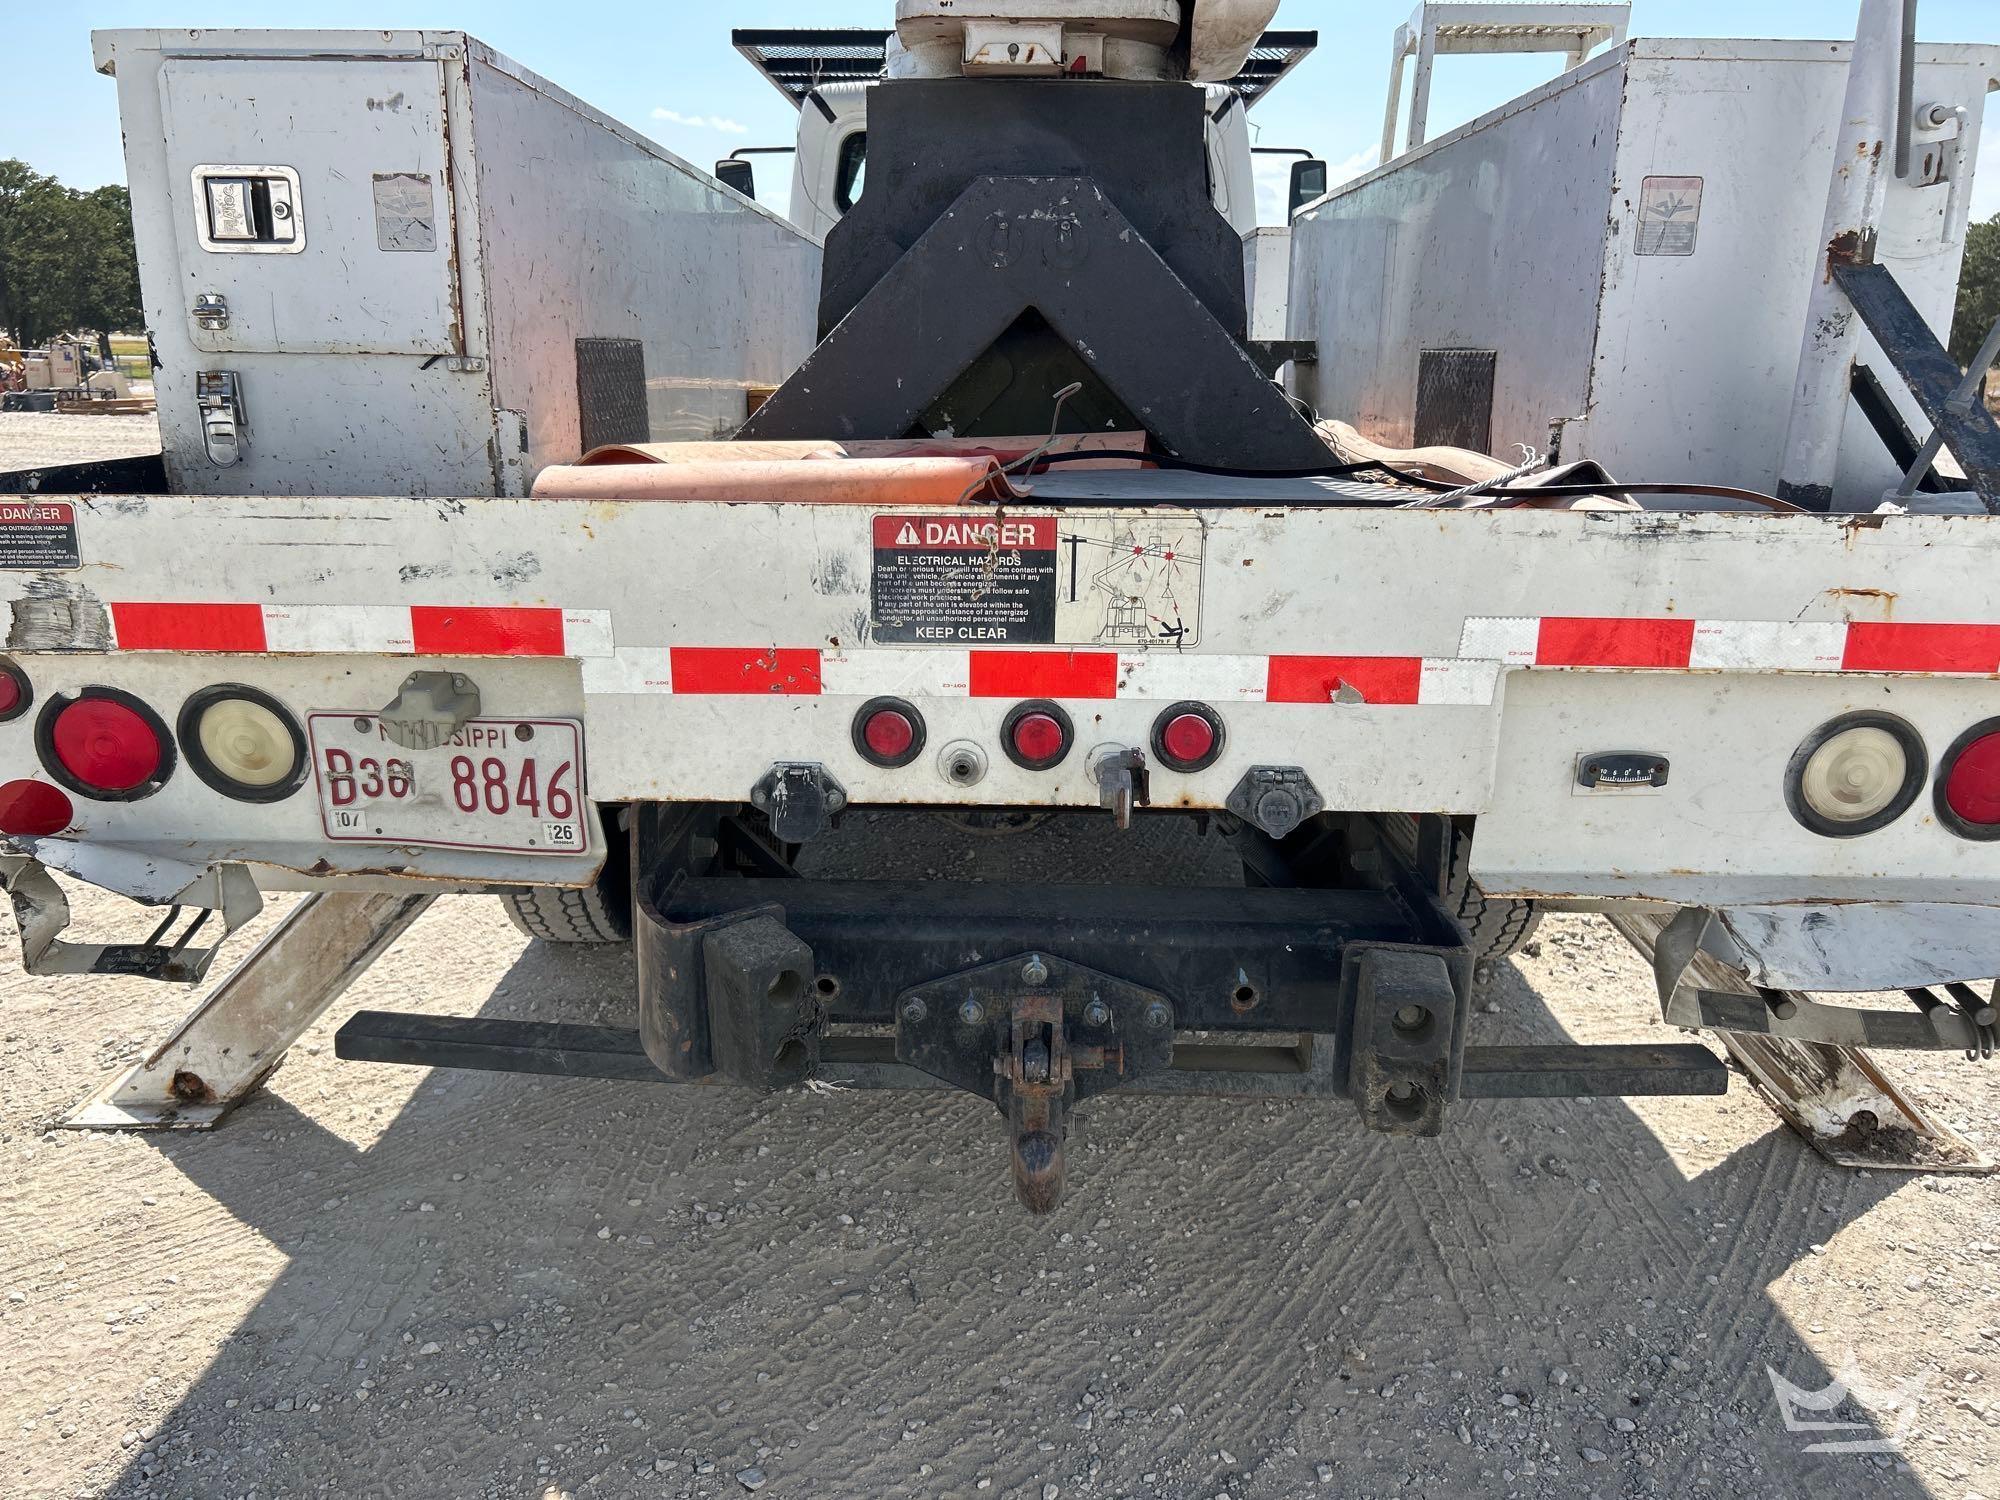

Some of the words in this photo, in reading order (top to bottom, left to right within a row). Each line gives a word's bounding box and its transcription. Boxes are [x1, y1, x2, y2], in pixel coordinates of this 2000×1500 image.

[2, 507, 61, 520] DANGER
[925, 523, 1036, 546] DANGER
[897, 555, 966, 566] ELECTRICAL
[877, 565, 898, 573] Death
[994, 609, 1029, 617] energized
[915, 627, 954, 639] KEEP
[958, 627, 1008, 639] CLEAR
[450, 755, 573, 820] 8846
[553, 825, 573, 840] 26
